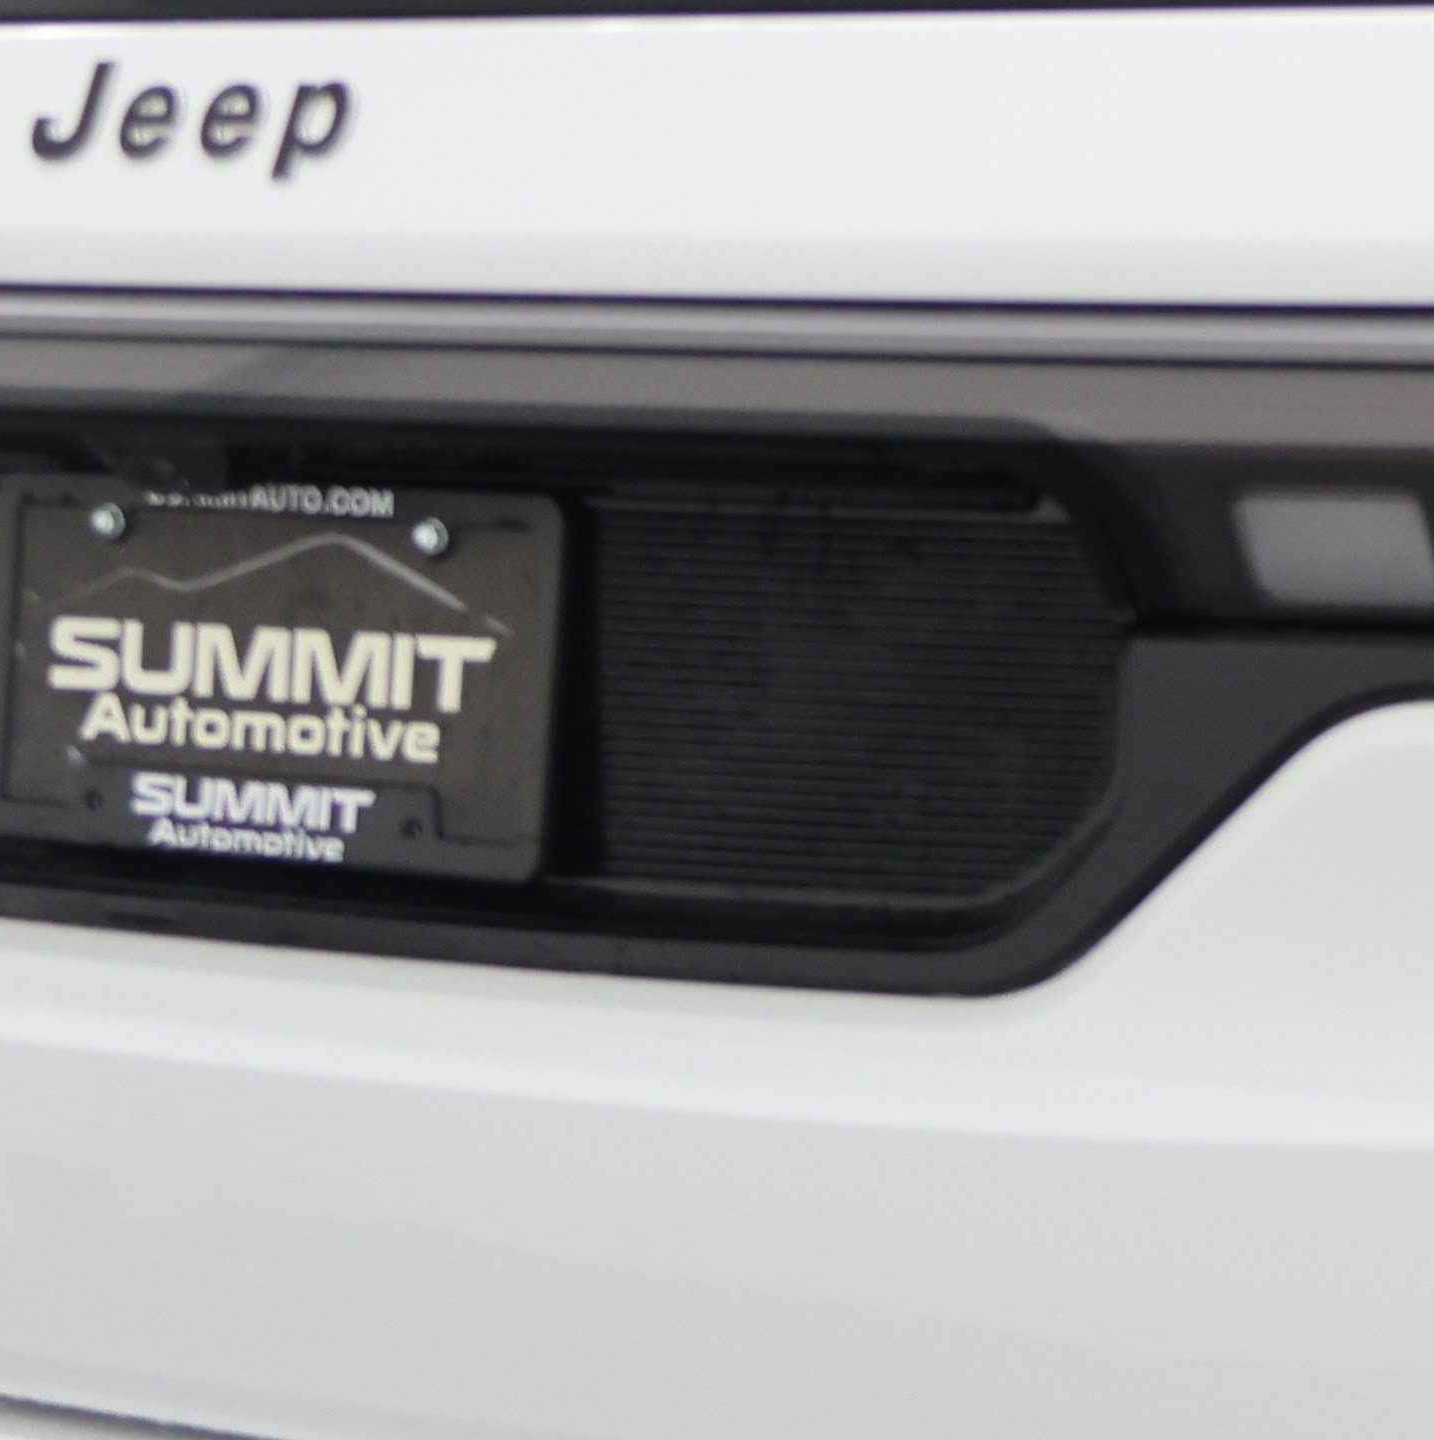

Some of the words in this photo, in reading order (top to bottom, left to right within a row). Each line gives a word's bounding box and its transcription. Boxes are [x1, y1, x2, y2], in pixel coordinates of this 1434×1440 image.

[30, 59, 354, 182] Jeep
[48, 616, 497, 712] SUMMIT
[79, 691, 441, 764] Automotive
[130, 771, 375, 832] SUMMIT
[146, 818, 345, 863] Automotive
